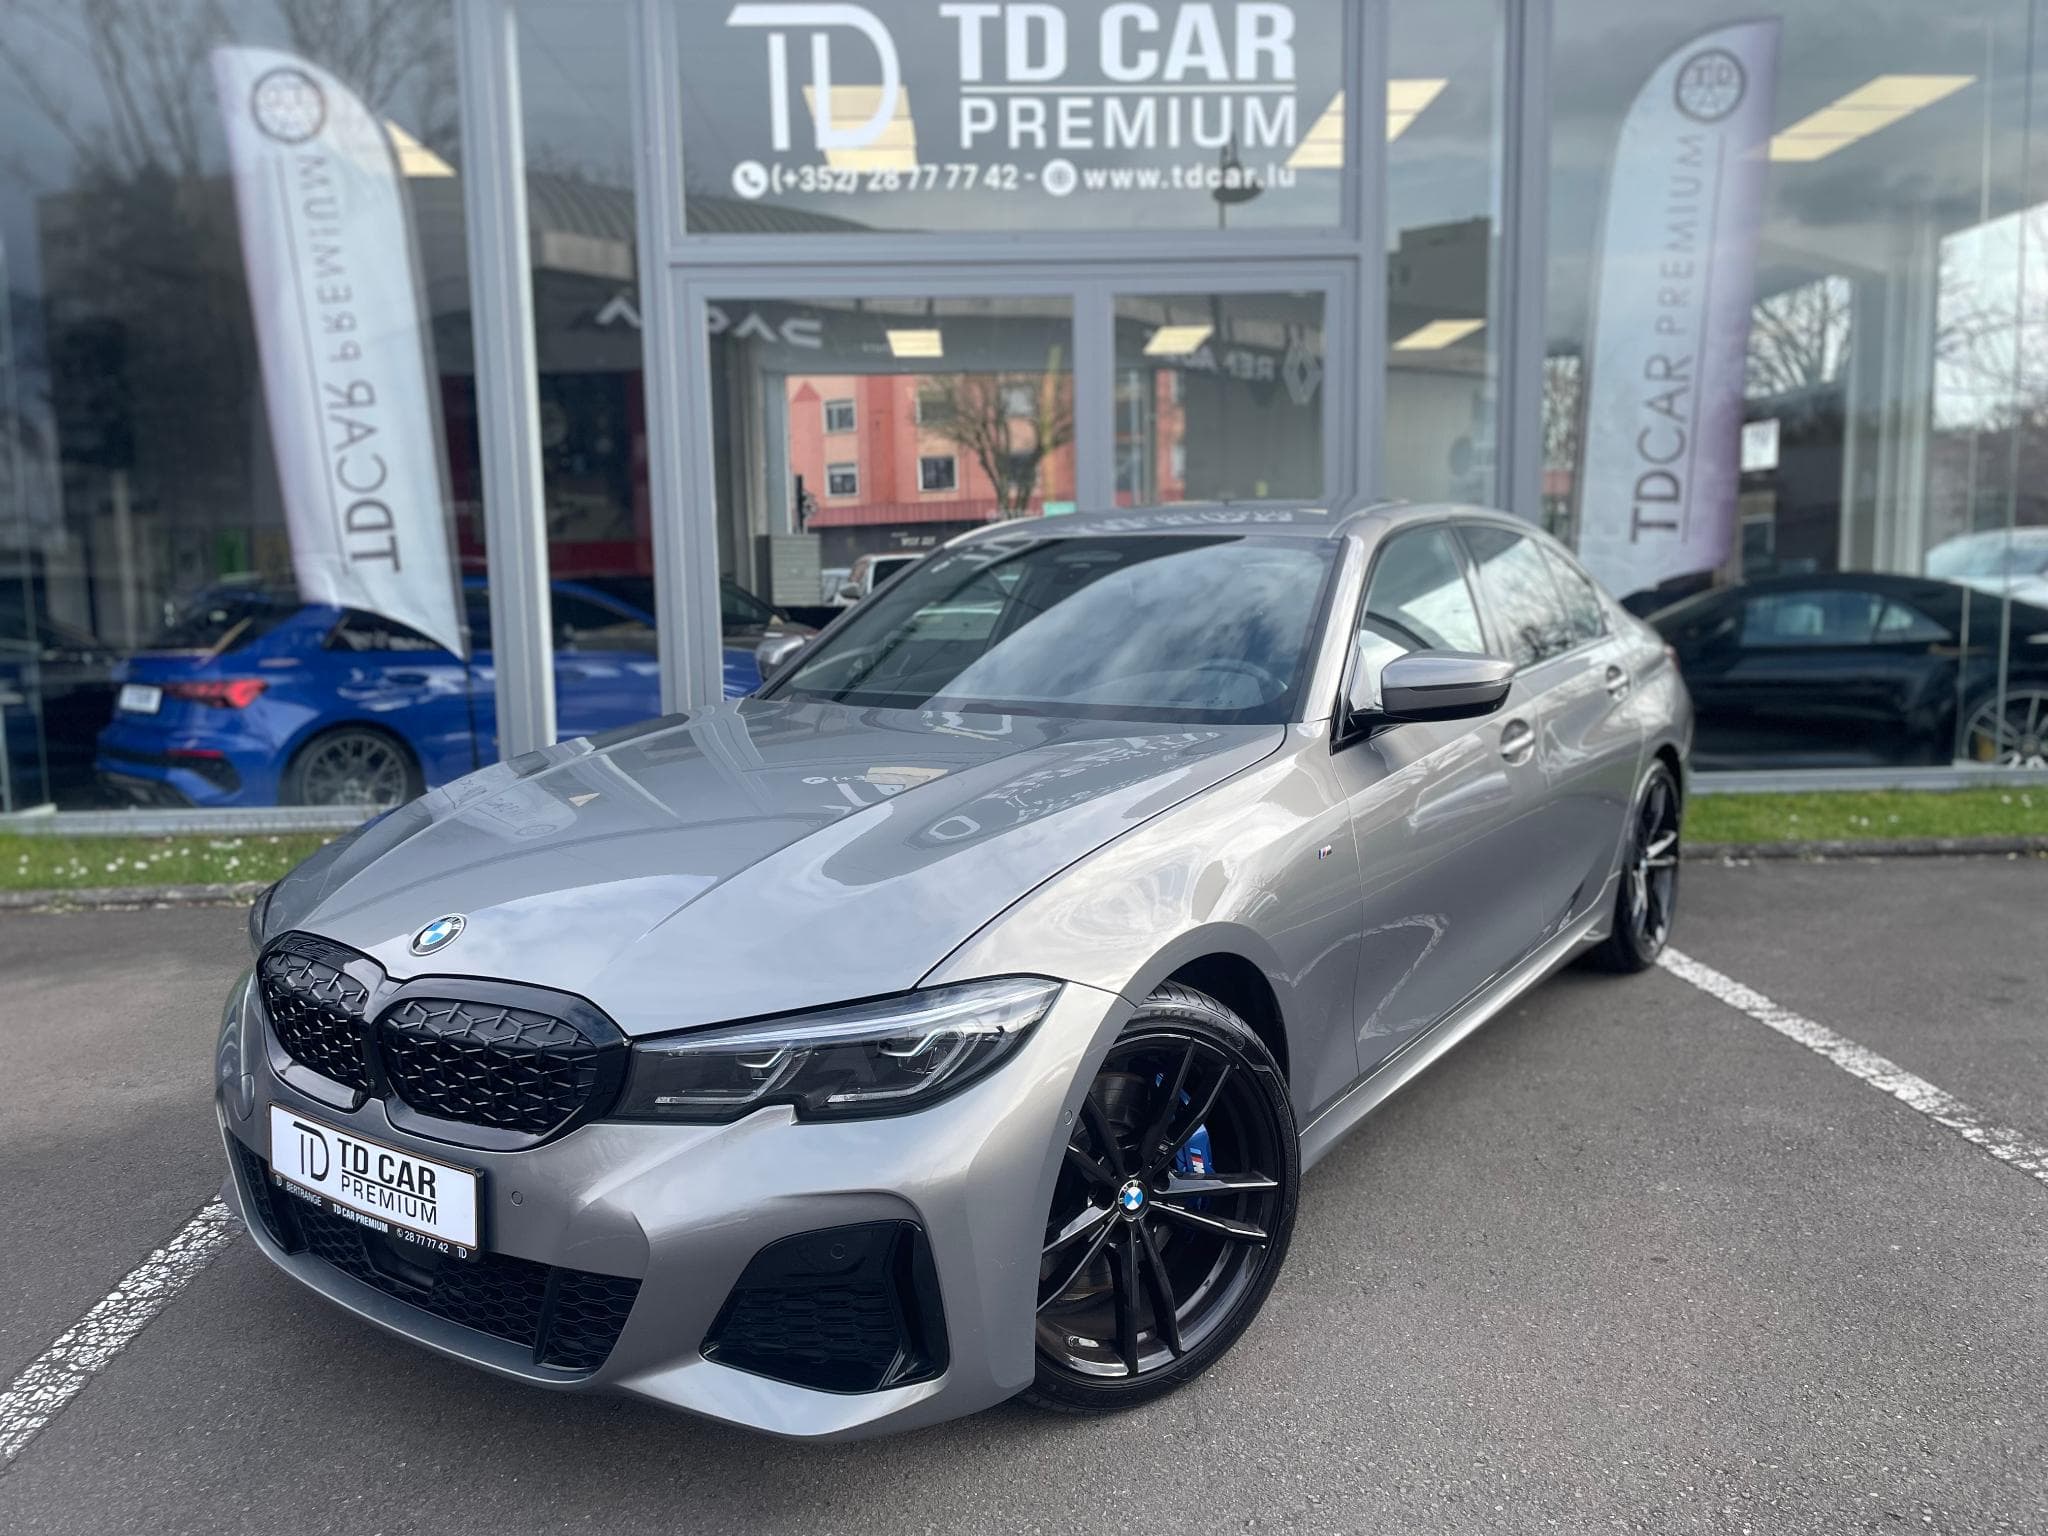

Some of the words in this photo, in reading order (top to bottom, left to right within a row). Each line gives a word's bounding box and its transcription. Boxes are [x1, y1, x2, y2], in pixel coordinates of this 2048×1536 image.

[939, 2, 1067, 82] TD
[1100, 2, 1295, 82] CAR
[960, 96, 1296, 149] PREMIUM
[771, 163, 858, 194] (+352)
[866, 166, 900, 191] 28
[907, 165, 938, 190] 77
[946, 165, 978, 190] 77
[983, 165, 1019, 191] 42
[1082, 163, 1297, 190] www.tdcar.lu
[1654, 132, 1705, 337] PREMIUM
[337, 1138, 369, 1175] TD
[378, 1154, 436, 1199] CAR
[286, 1181, 322, 1207] BERTRANGE
[333, 1204, 341, 1215] TD
[342, 1207, 355, 1222] CAR
[356, 1213, 389, 1233] PREMIUM
[405, 1230, 415, 1242] 28
[416, 1234, 426, 1246] 77
[427, 1237, 437, 1249] 77
[438, 1241, 449, 1253] 42
[342, 1175, 437, 1225] PREMIUM
